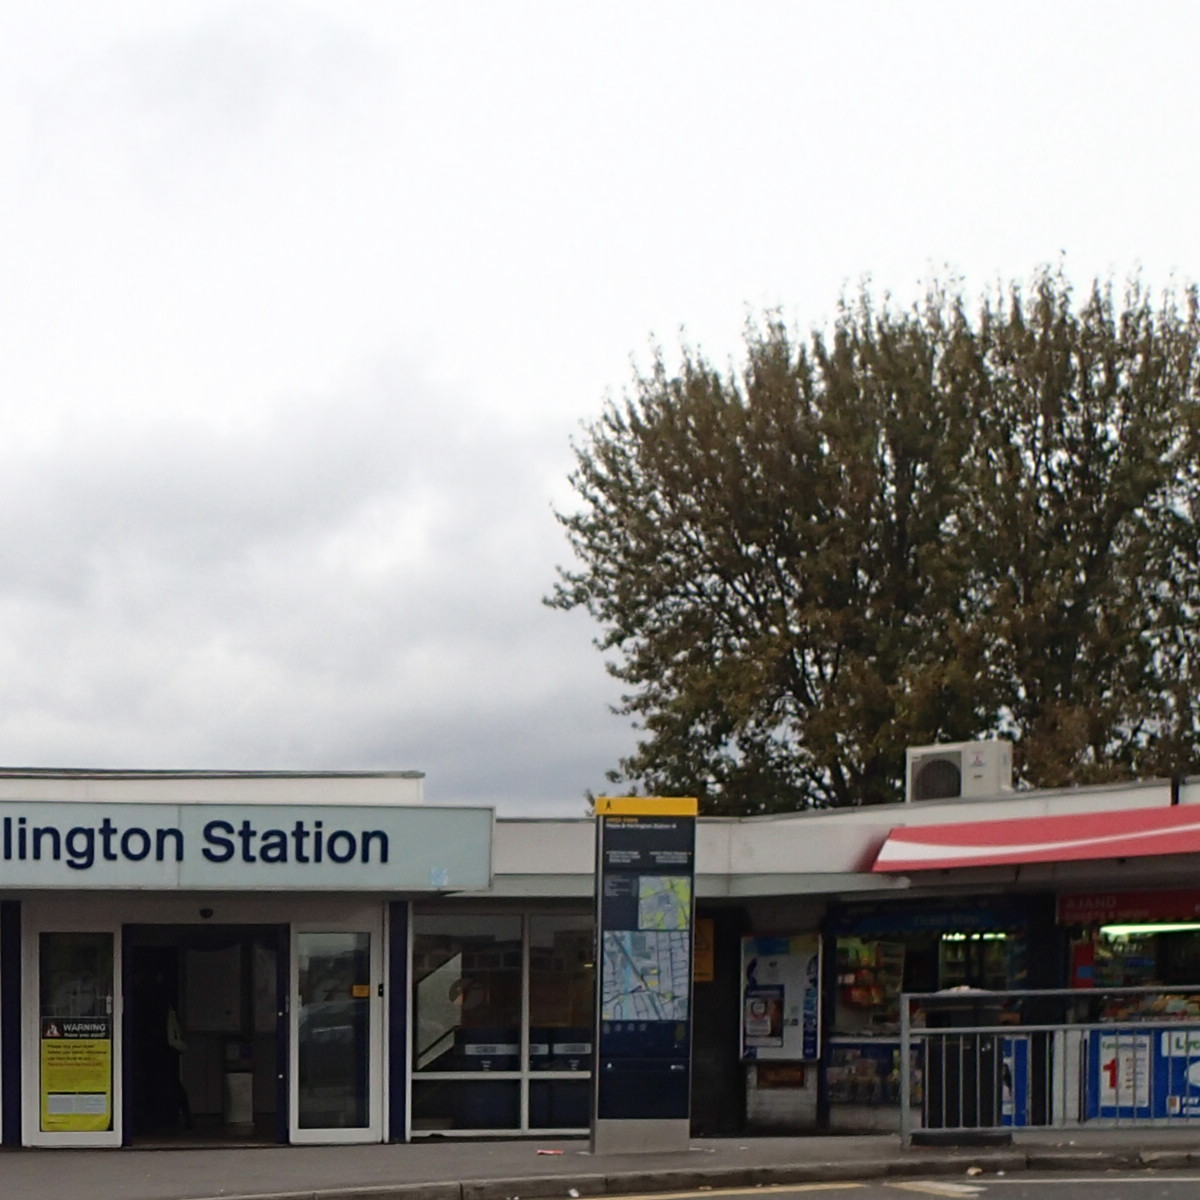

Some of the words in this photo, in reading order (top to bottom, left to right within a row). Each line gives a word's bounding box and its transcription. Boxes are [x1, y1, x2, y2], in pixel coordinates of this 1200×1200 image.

[201, 819, 390, 866] Station
[63, 1023, 106, 1031] WARNING
[1103, 1058, 1117, 1089] 1
